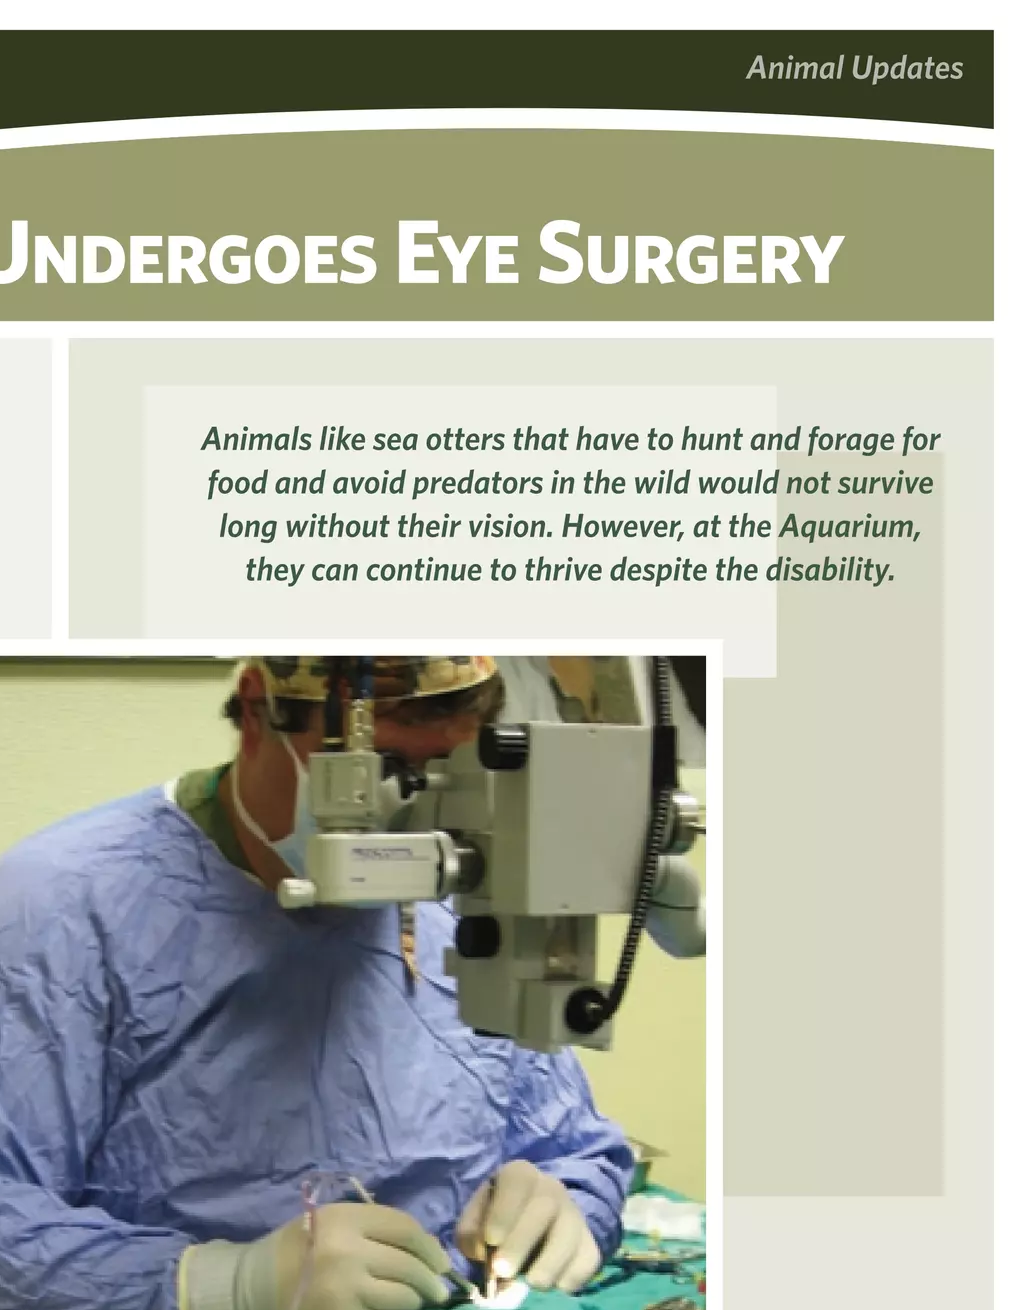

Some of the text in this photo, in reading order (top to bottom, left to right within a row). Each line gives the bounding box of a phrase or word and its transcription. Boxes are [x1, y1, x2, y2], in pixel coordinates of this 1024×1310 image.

[746, 54, 963, 85] Animal Updates
[200, 426, 941, 456] Animals like sea otters that have to hunt and forage for
[208, 469, 933, 500] food and avoid predators in the wild would not survive
[220, 513, 920, 543] long without their vision. However, at the Aquarium,
[246, 556, 894, 587] they can continue to thrive despite the disability.
